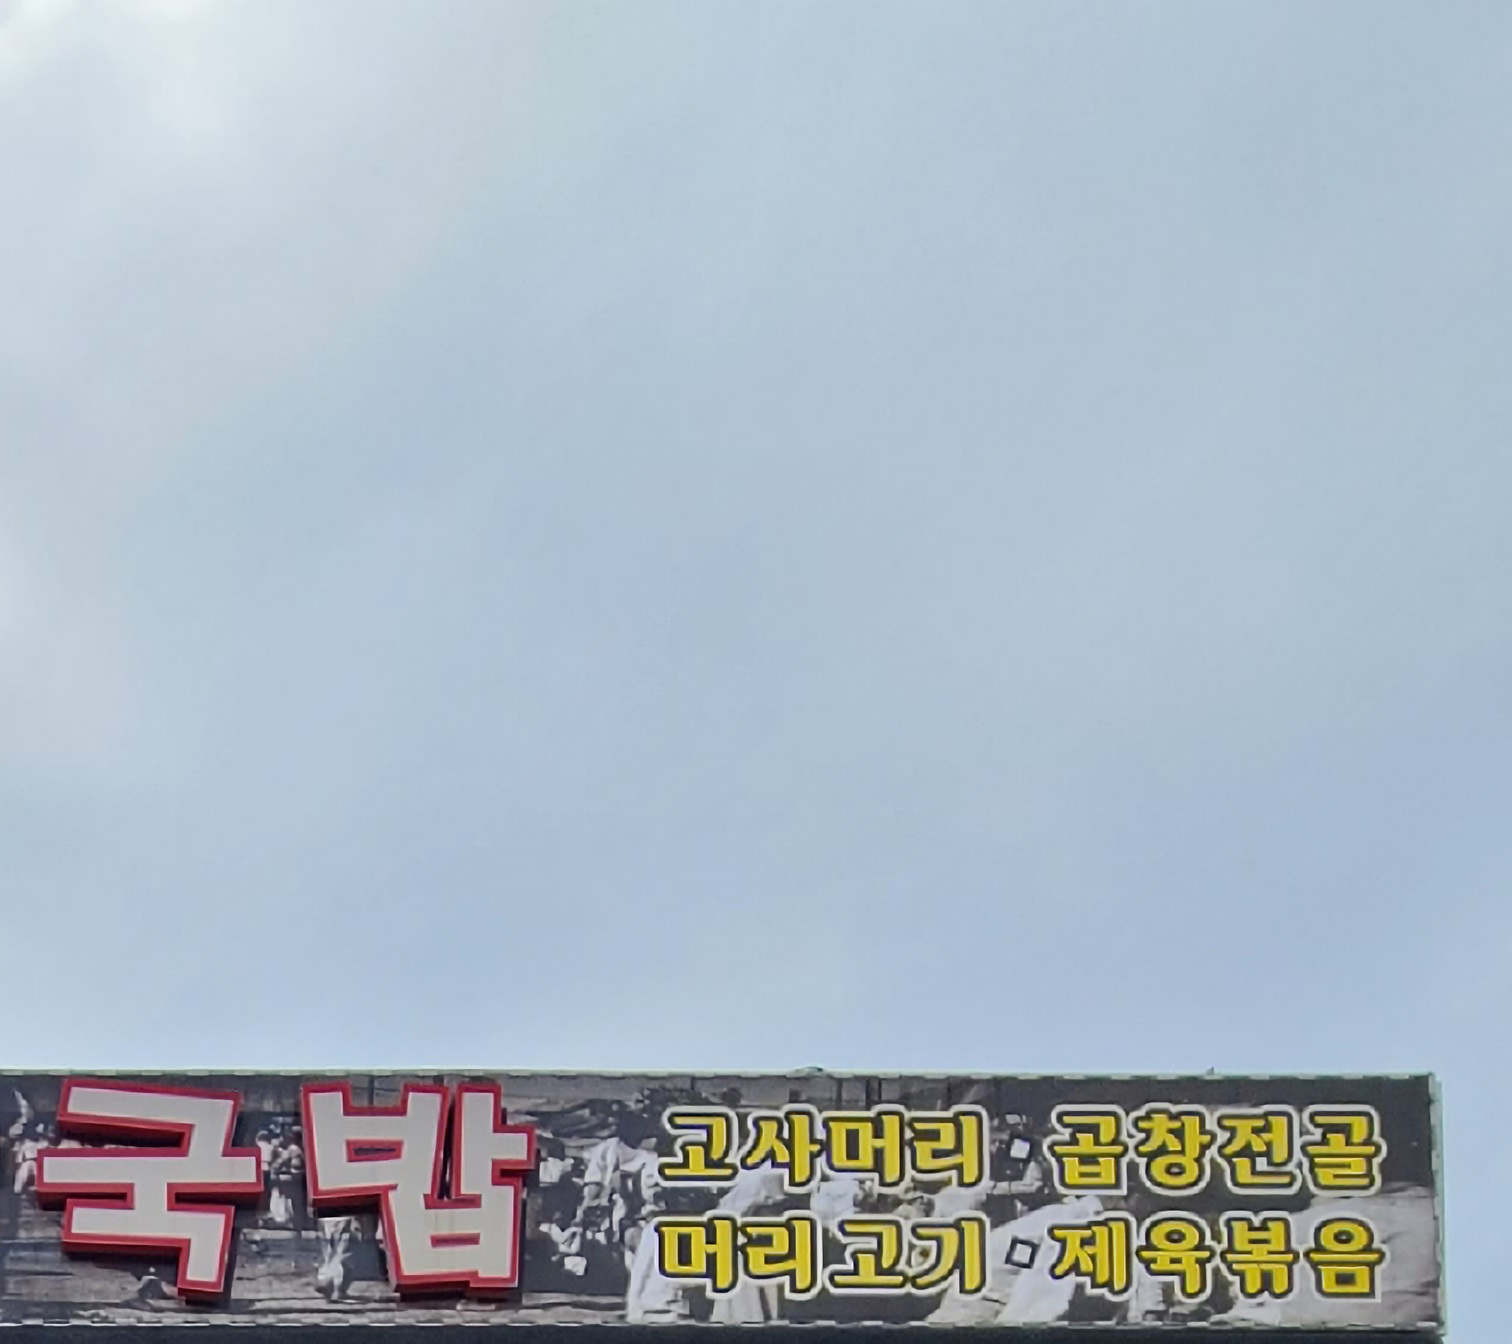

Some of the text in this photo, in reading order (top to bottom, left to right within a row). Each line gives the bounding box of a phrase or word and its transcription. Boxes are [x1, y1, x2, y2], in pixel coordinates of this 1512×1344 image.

[658, 1110, 1381, 1190] 고사머리 곱창전골
[656, 1216, 1384, 1296] 머리고기 제육볶음
